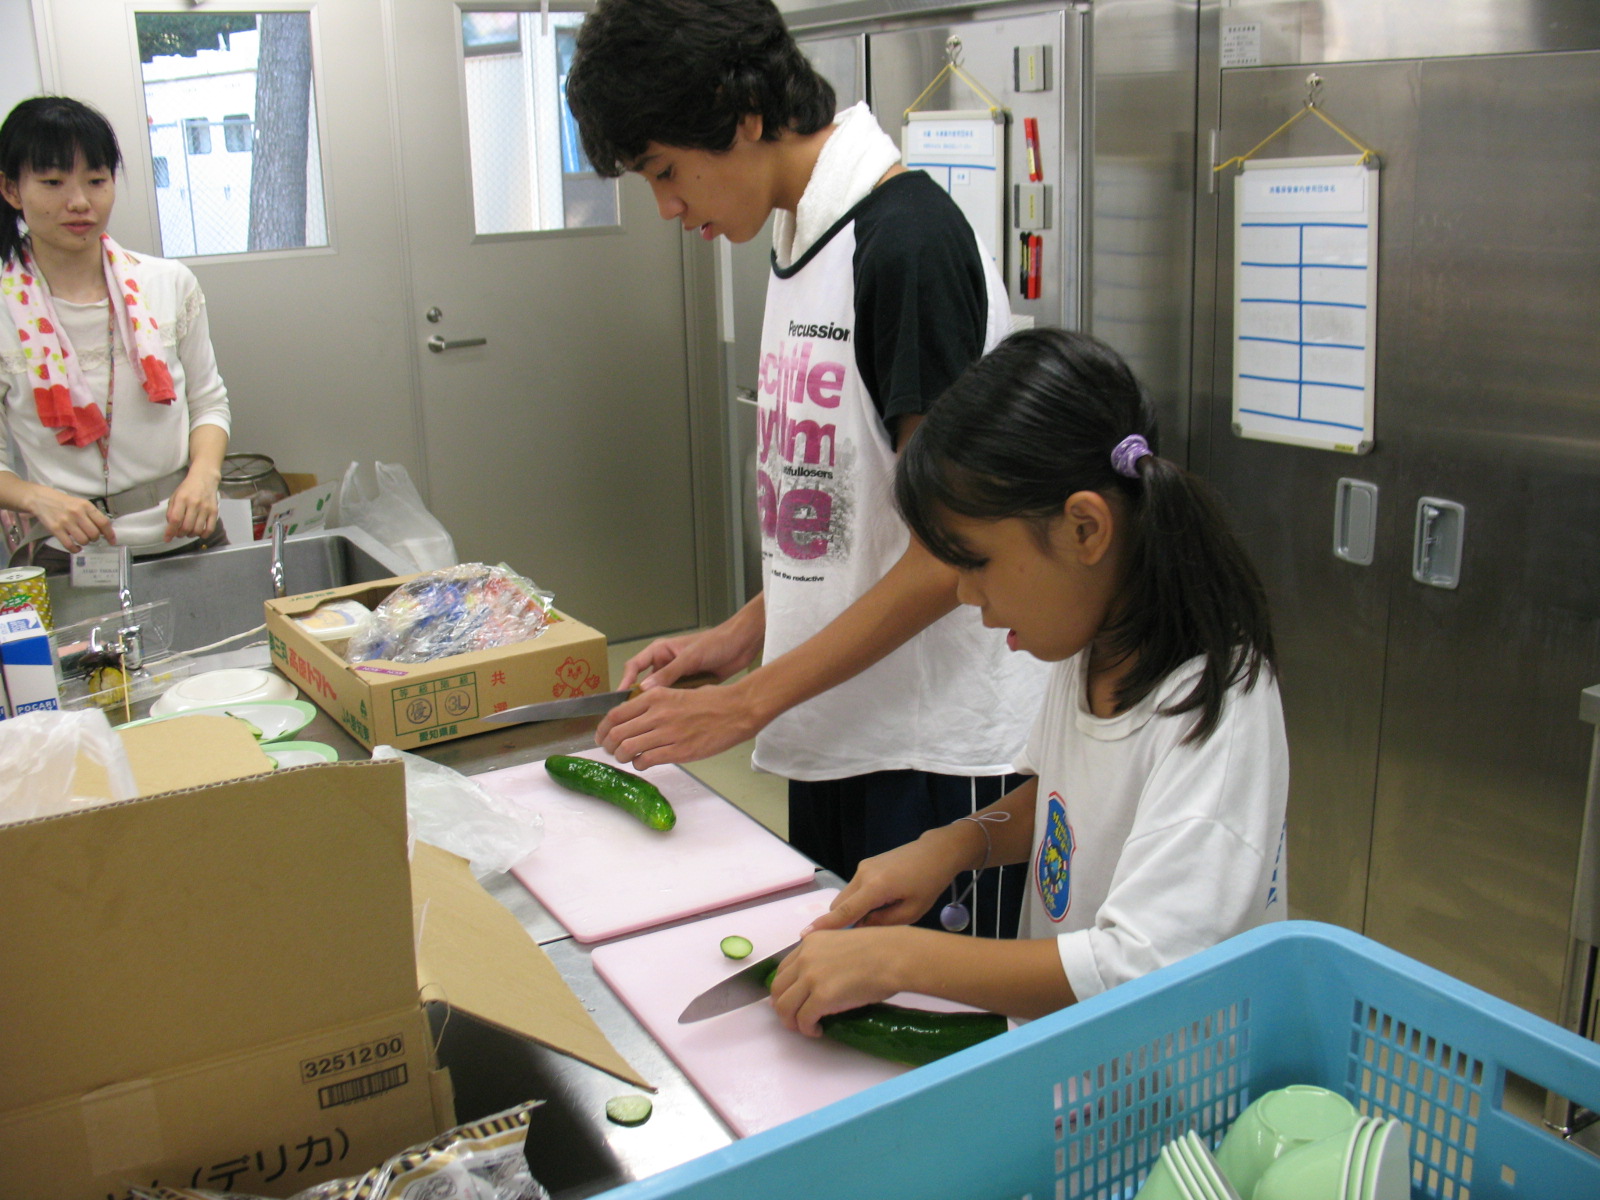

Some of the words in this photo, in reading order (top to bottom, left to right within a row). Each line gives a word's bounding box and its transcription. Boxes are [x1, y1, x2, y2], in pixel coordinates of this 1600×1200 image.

[782, 572, 792, 580] the
[18, 700, 56, 714] POCARI
[448, 694, 468, 712] 3L
[419, 725, 458, 742] 愛知県産
[303, 1037, 403, 1079] 3251200
[190, 1127, 350, 1192] (デリカ)
